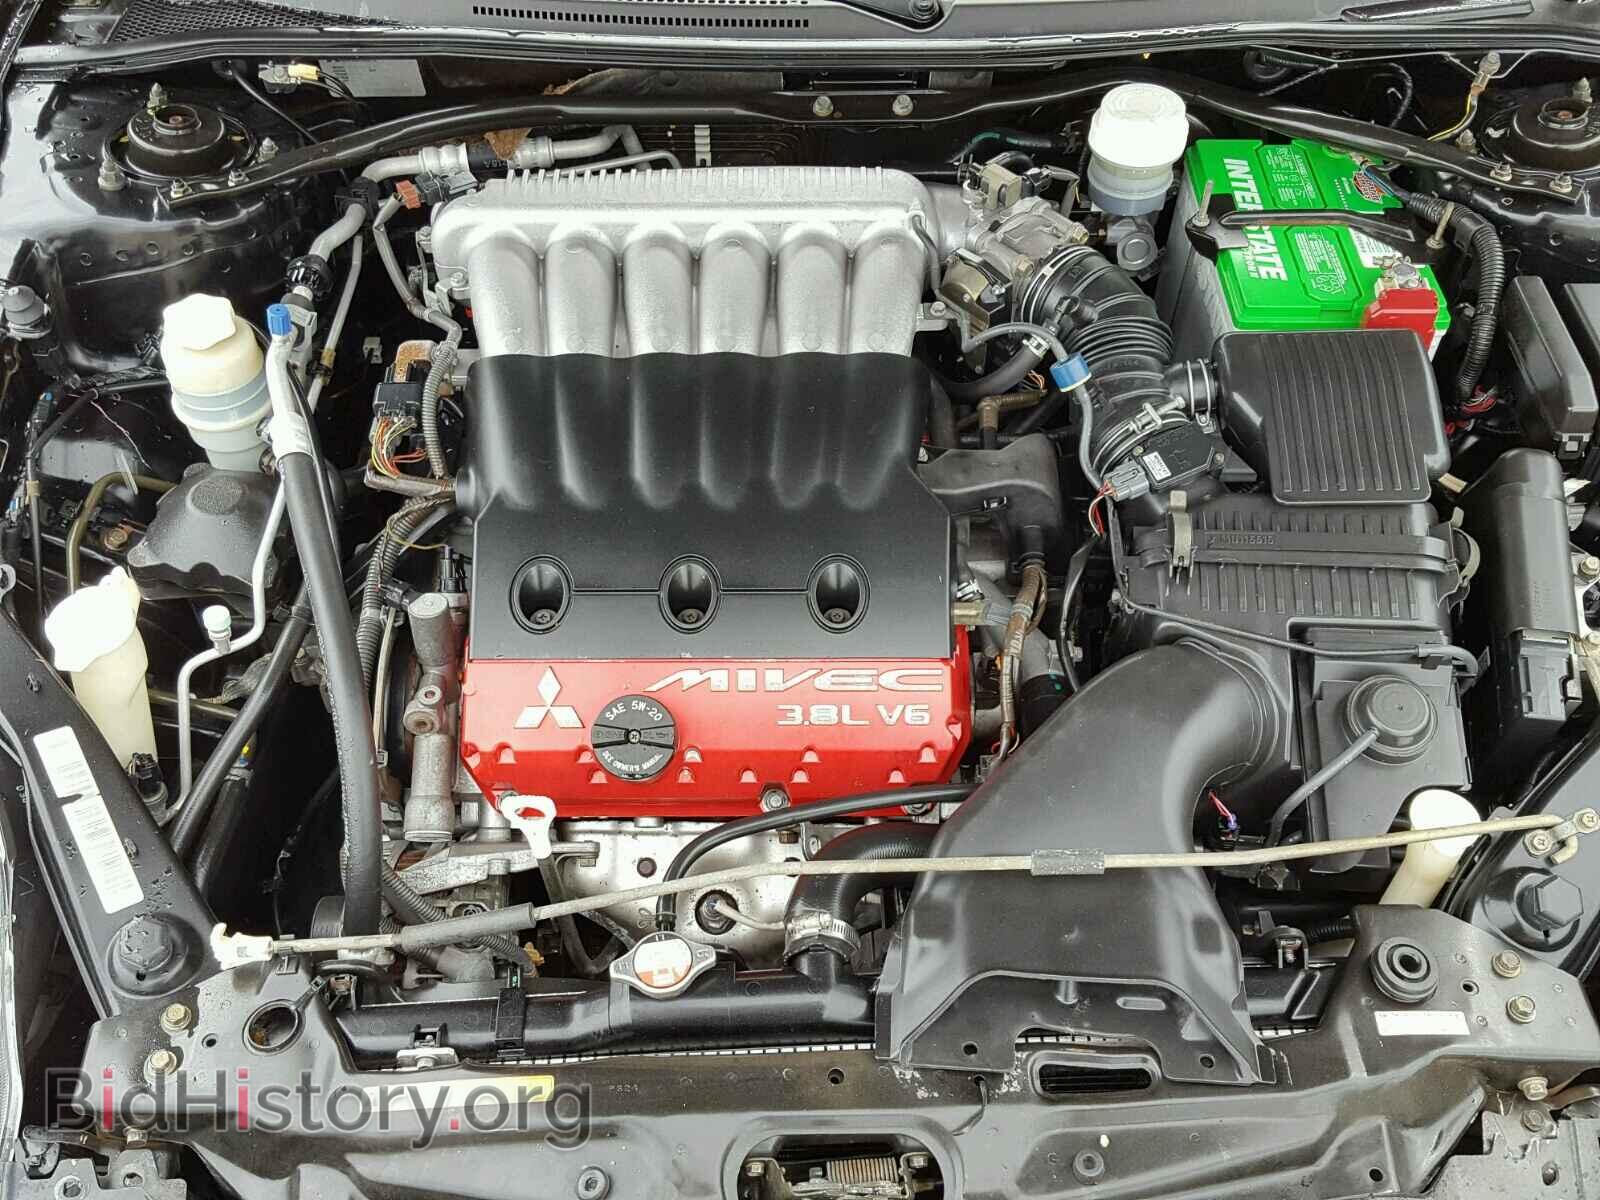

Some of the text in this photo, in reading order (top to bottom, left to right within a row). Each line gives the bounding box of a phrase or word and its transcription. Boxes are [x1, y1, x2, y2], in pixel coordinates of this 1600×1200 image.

[642, 668, 945, 692] MIVEC
[605, 700, 663, 721] SAE 5W-20
[776, 703, 931, 726] 3.8L V6
